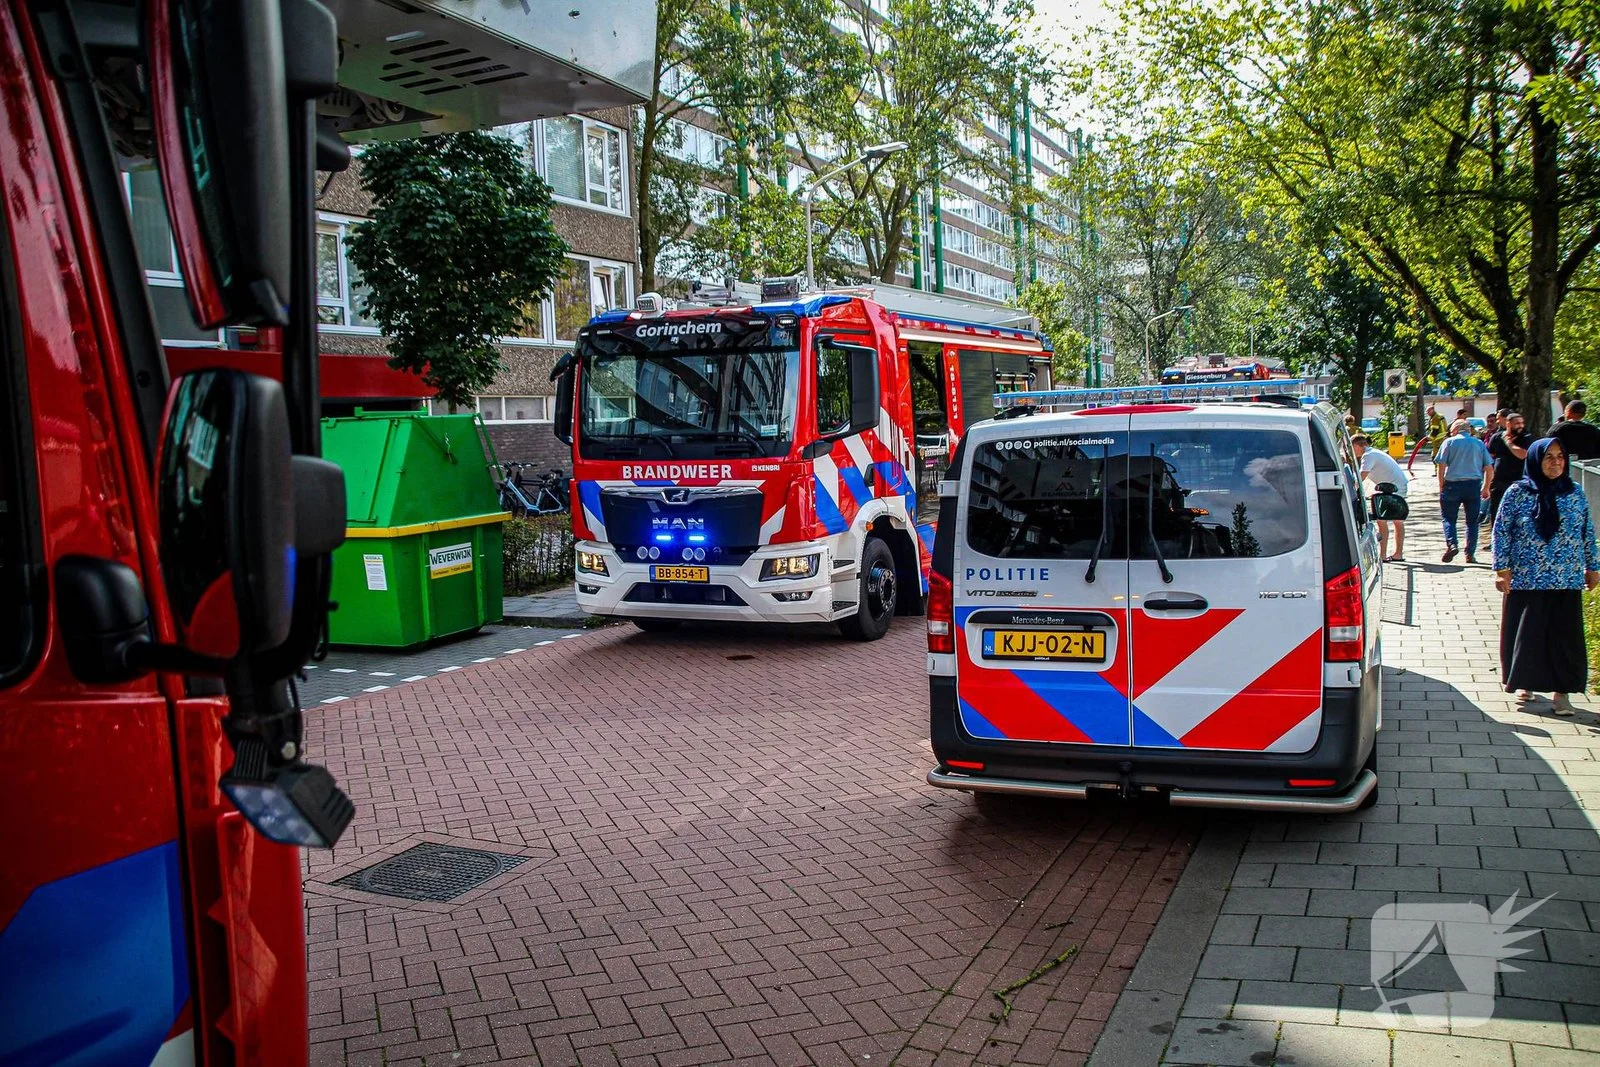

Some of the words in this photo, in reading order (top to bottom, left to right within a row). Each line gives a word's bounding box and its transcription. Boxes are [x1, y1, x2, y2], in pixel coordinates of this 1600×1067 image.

[635, 321, 722, 338] Gorinchem
[1186, 373, 1227, 381] Giessenburg
[1033, 437, 1115, 449] politie.nl/socialmedia
[622, 464, 732, 479] BRANDWEER
[652, 517, 704, 529] MAN
[429, 548, 472, 565] WEVERWIJK
[658, 568, 704, 579] BB-854-T
[966, 568, 1049, 581] POLITIE
[966, 589, 996, 597] VITO
[1011, 616, 1065, 625] Mercedes-Benz
[1003, 634, 1095, 654] KJJ-02-N
